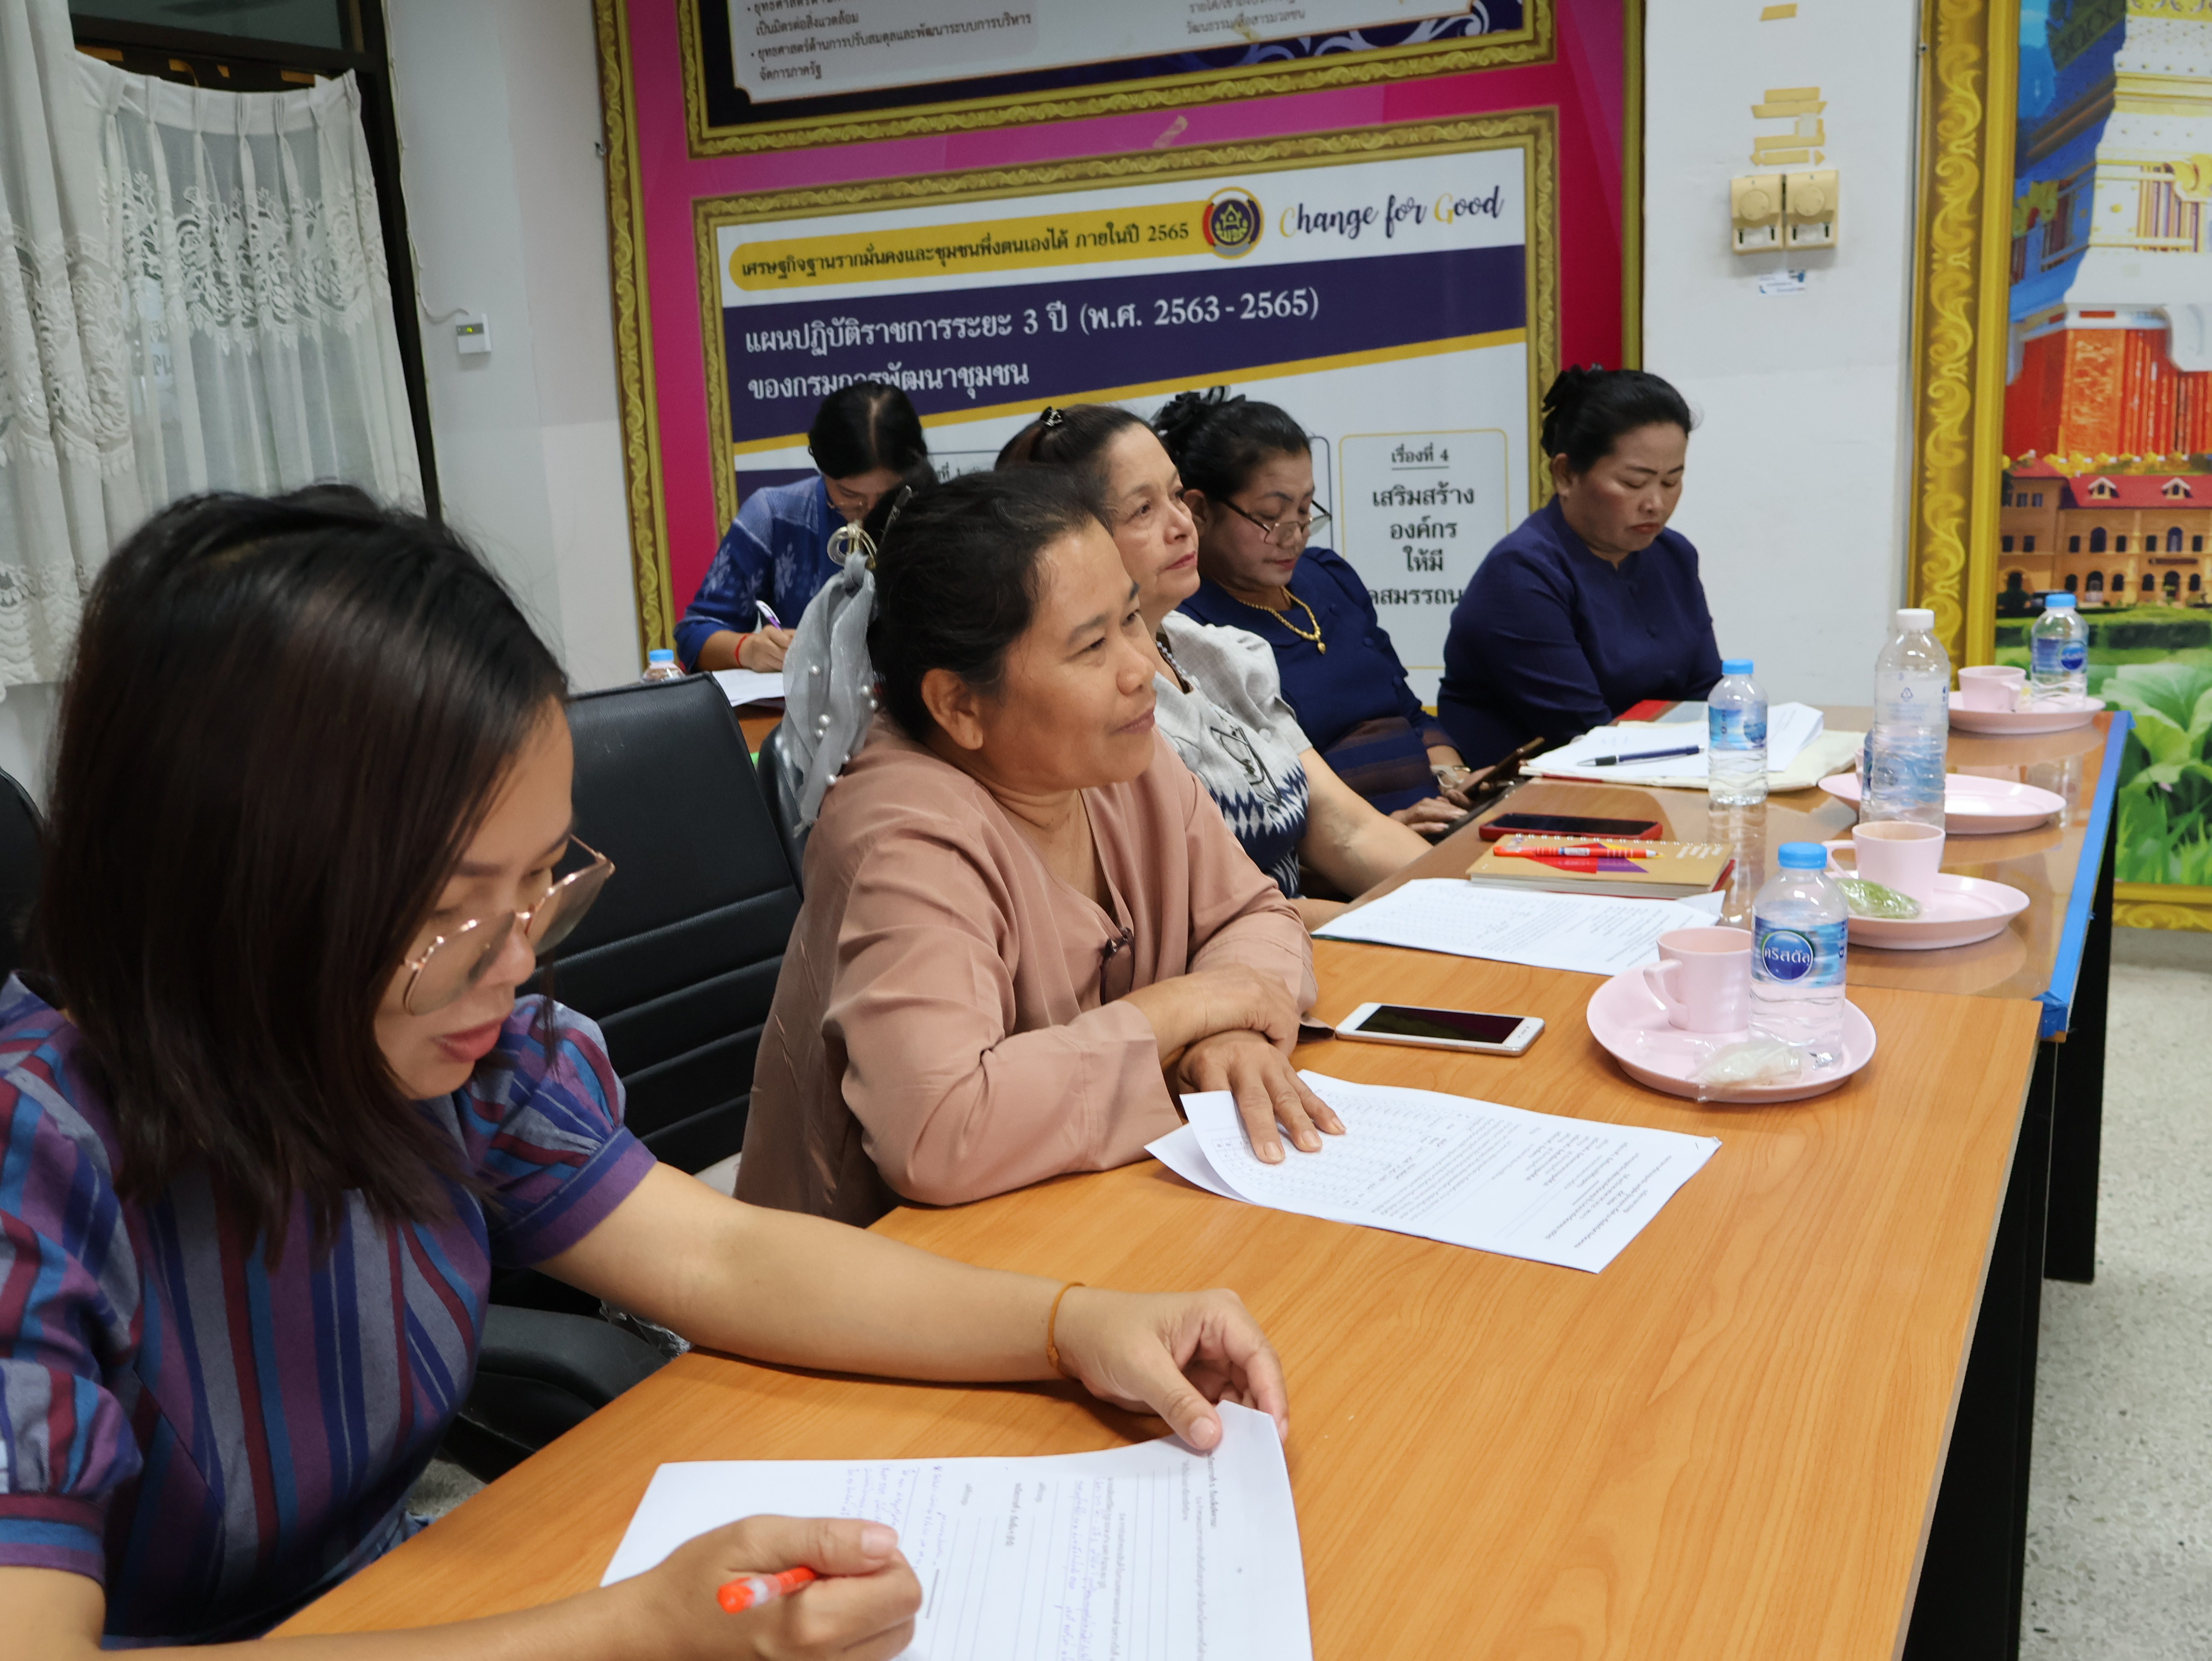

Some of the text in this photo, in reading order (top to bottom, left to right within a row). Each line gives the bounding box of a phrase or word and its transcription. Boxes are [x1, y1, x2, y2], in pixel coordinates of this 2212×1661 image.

[760, 61, 822, 81] จัดการภาครัฐ
[1279, 185, 1505, 240] Change for Good
[742, 221, 1189, 279] เศรษฐกิจฐานรากมั่นคงและชุมชนพึ่งตนเองได้ ภายในปี 2565
[747, 314, 1012, 356] แผนปฏิบัติราชการระยะ
[1023, 309, 1038, 334] 3
[1046, 300, 1068, 332] ปี
[1080, 303, 1143, 336] (พ.ศ.
[1154, 295, 1220, 326] 2563
[1240, 287, 1319, 320] 2565)
[1391, 442, 1449, 463] เรื่องที่ 4
[1373, 481, 1475, 507] เสริมสร้าง
[1390, 515, 1458, 539] องค์กร
[1402, 545, 1444, 573] ให้มี
[1764, 947, 1810, 966] คริสตัล
